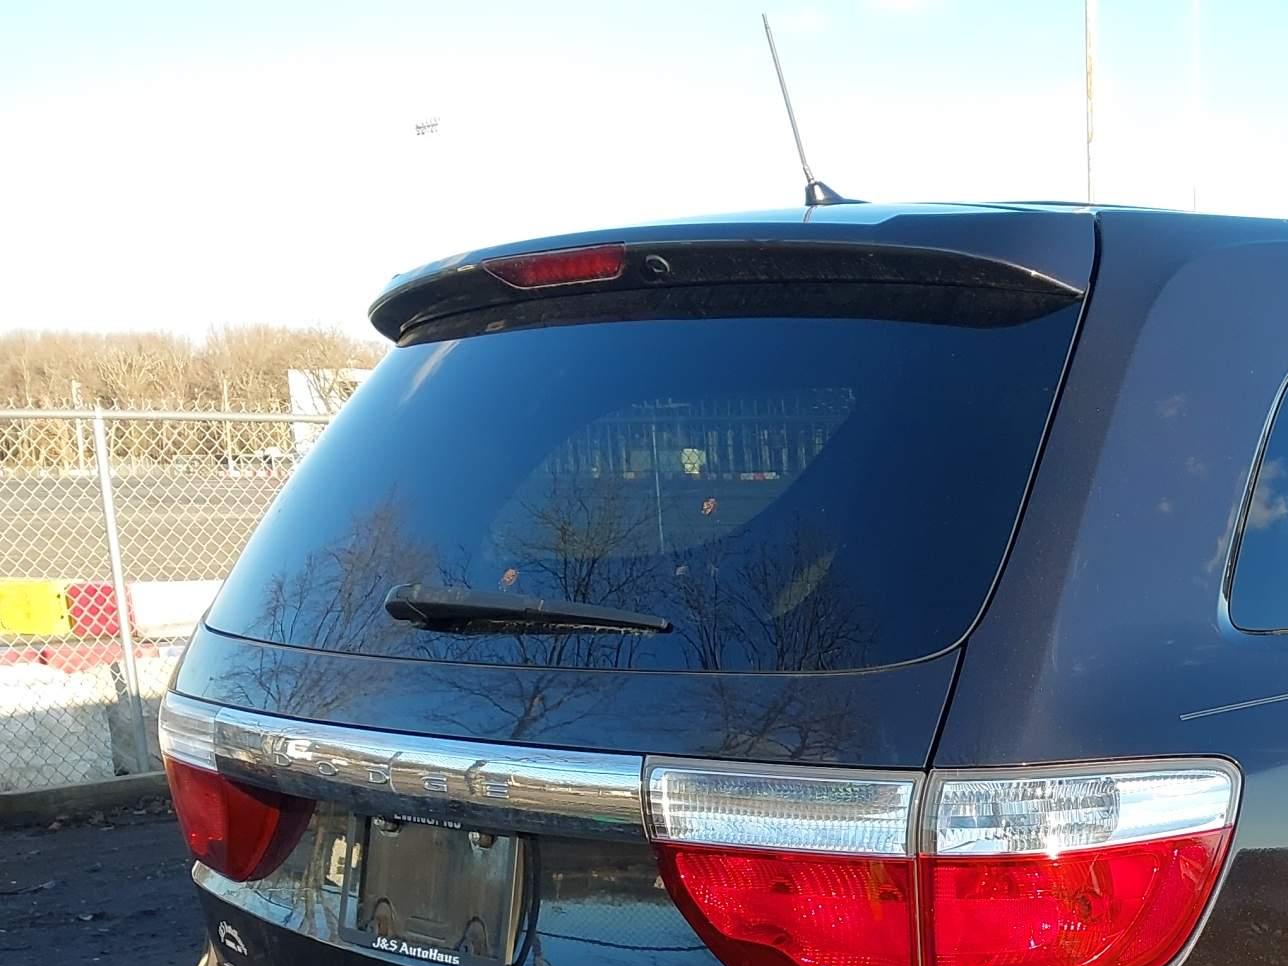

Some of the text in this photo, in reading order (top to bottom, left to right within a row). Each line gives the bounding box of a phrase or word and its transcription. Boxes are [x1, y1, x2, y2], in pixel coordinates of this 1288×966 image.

[273, 751, 511, 799] DODGE
[372, 936, 461, 965] J&S AutoHaus
